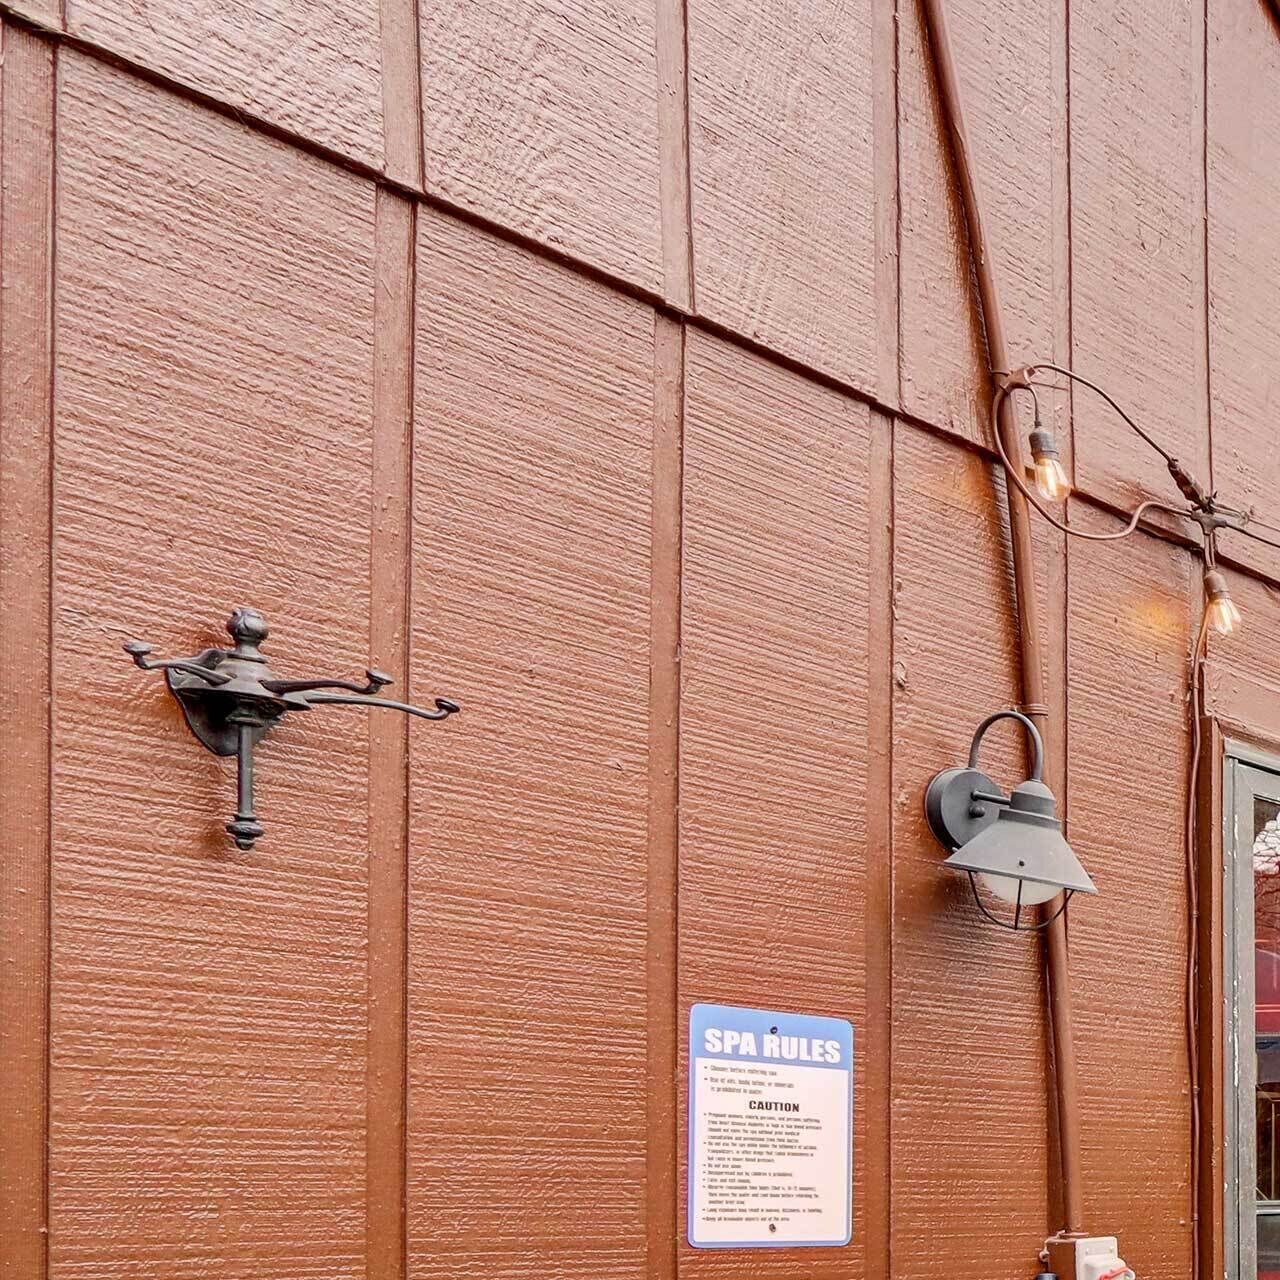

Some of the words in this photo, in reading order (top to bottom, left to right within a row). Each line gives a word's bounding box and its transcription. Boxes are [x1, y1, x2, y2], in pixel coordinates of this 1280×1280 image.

[704, 1028, 757, 1056] SPA
[763, 1034, 841, 1064] RULES
[749, 1100, 800, 1112] CAUTION
